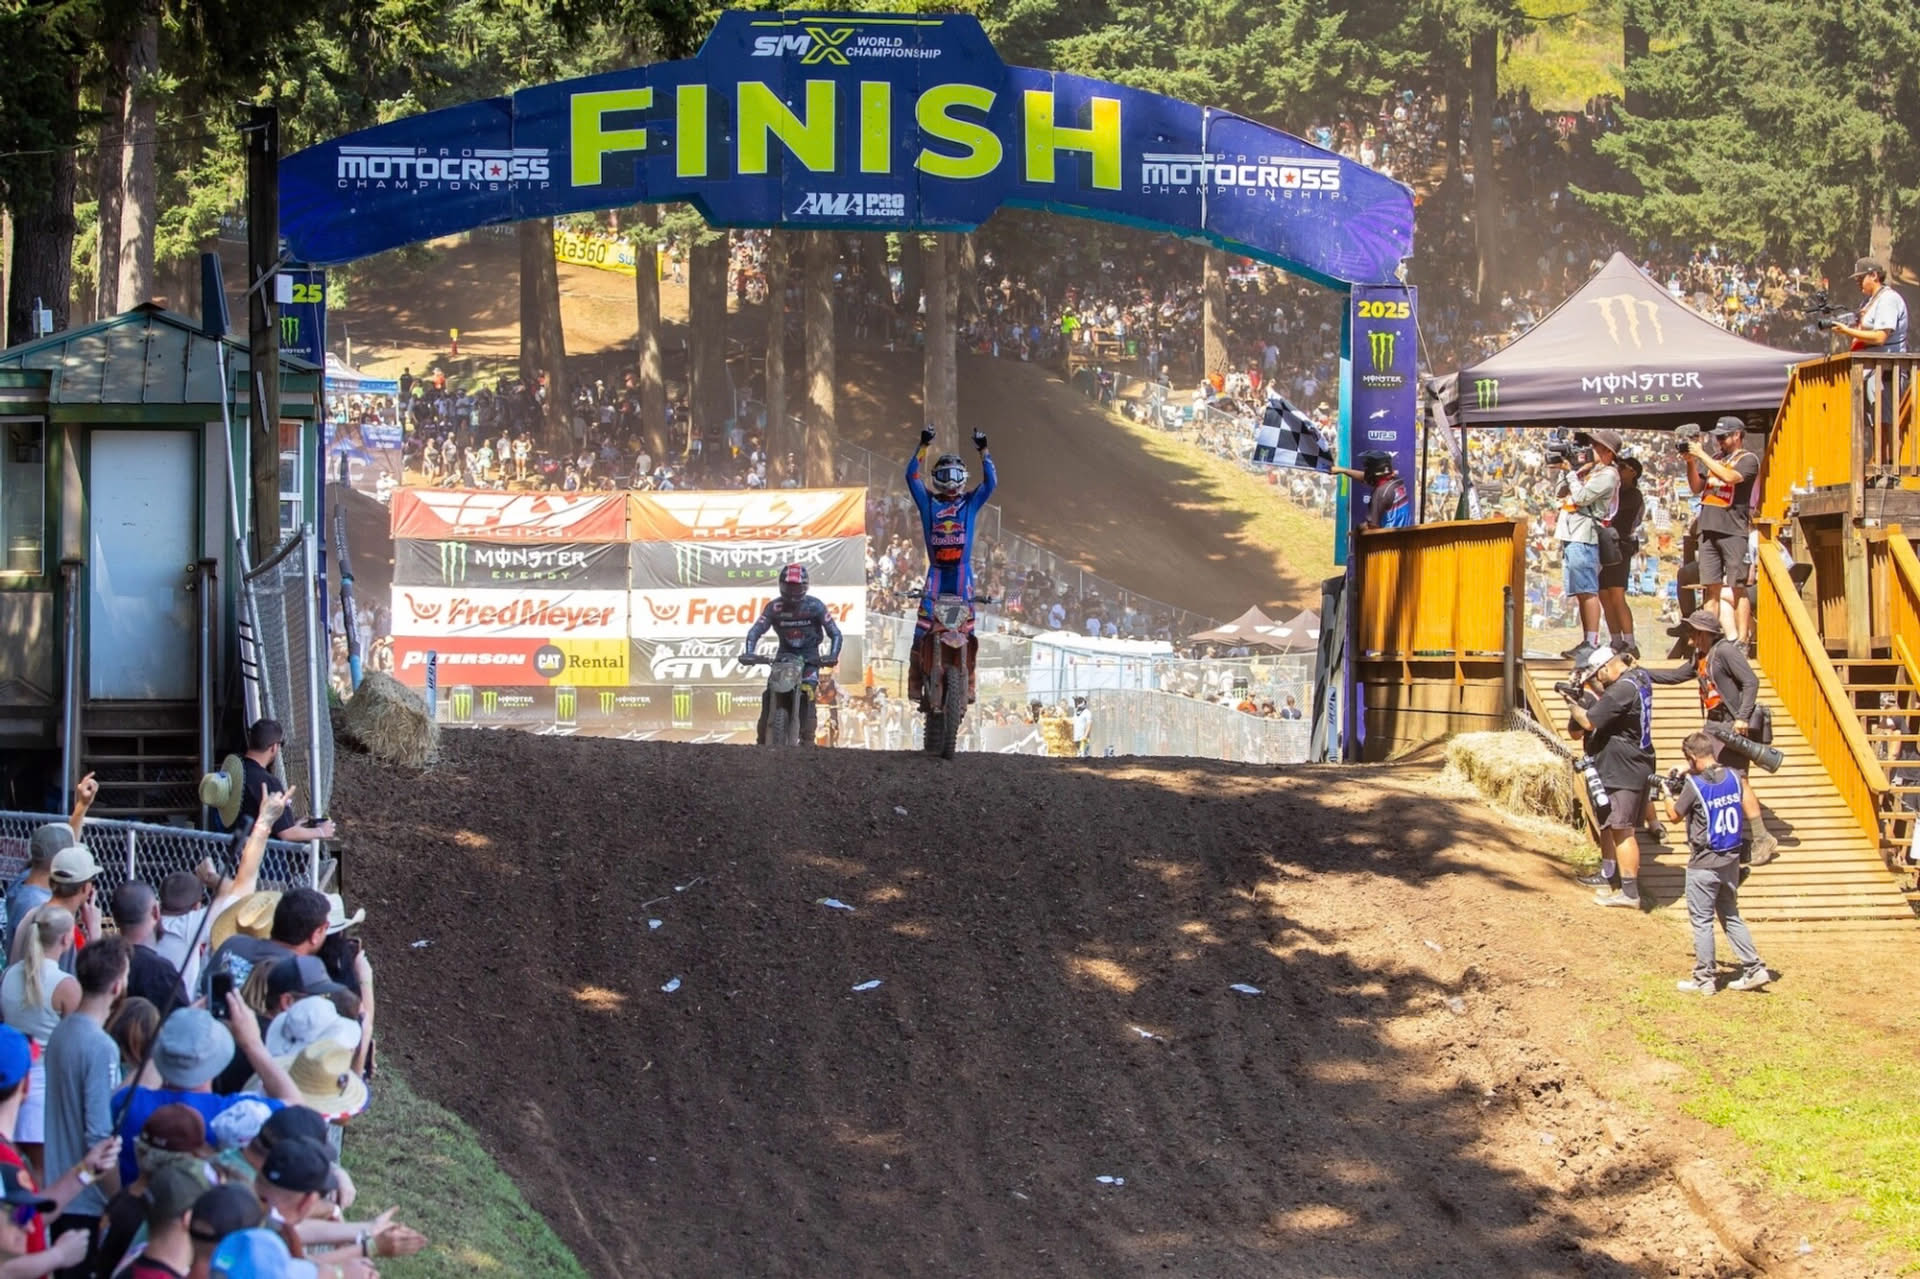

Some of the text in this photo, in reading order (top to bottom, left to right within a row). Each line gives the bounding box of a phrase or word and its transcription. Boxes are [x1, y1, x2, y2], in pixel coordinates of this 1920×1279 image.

[751, 27, 854, 64] SMX
[857, 37, 902, 46] WORLD
[846, 47, 941, 59] CHAMPIONSHIP
[571, 80, 1122, 190] FINISH
[418, 147, 472, 157] PRO
[1217, 154, 1268, 164] PRO
[338, 156, 550, 181] MOTOCROSS
[1142, 163, 1340, 190] MOTOCROSS
[338, 180, 550, 191] CHAMPIONSHIP
[1142, 186, 1341, 200] CHAMPIONSHIP
[793, 193, 905, 215] AMA PRO
[866, 208, 905, 216] RACING
[292, 284, 323, 303] 25
[1357, 300, 1410, 318] 2025
[1363, 375, 1402, 383] MONSTER
[1582, 371, 1703, 392] MONSTER
[1600, 393, 1684, 405] ENERGY
[692, 528, 804, 537] RACING
[475, 548, 588, 568] MONSTER
[710, 547, 824, 567] MONSTER
[492, 571, 571, 579] ENERGY
[727, 570, 778, 578] ENER
[944, 607, 960, 624] 1
[679, 642, 735, 657] ROCKY
[538, 654, 624, 669] CAT Rental
[1708, 792, 1739, 809] PRESS
[1715, 807, 1739, 836] 40
